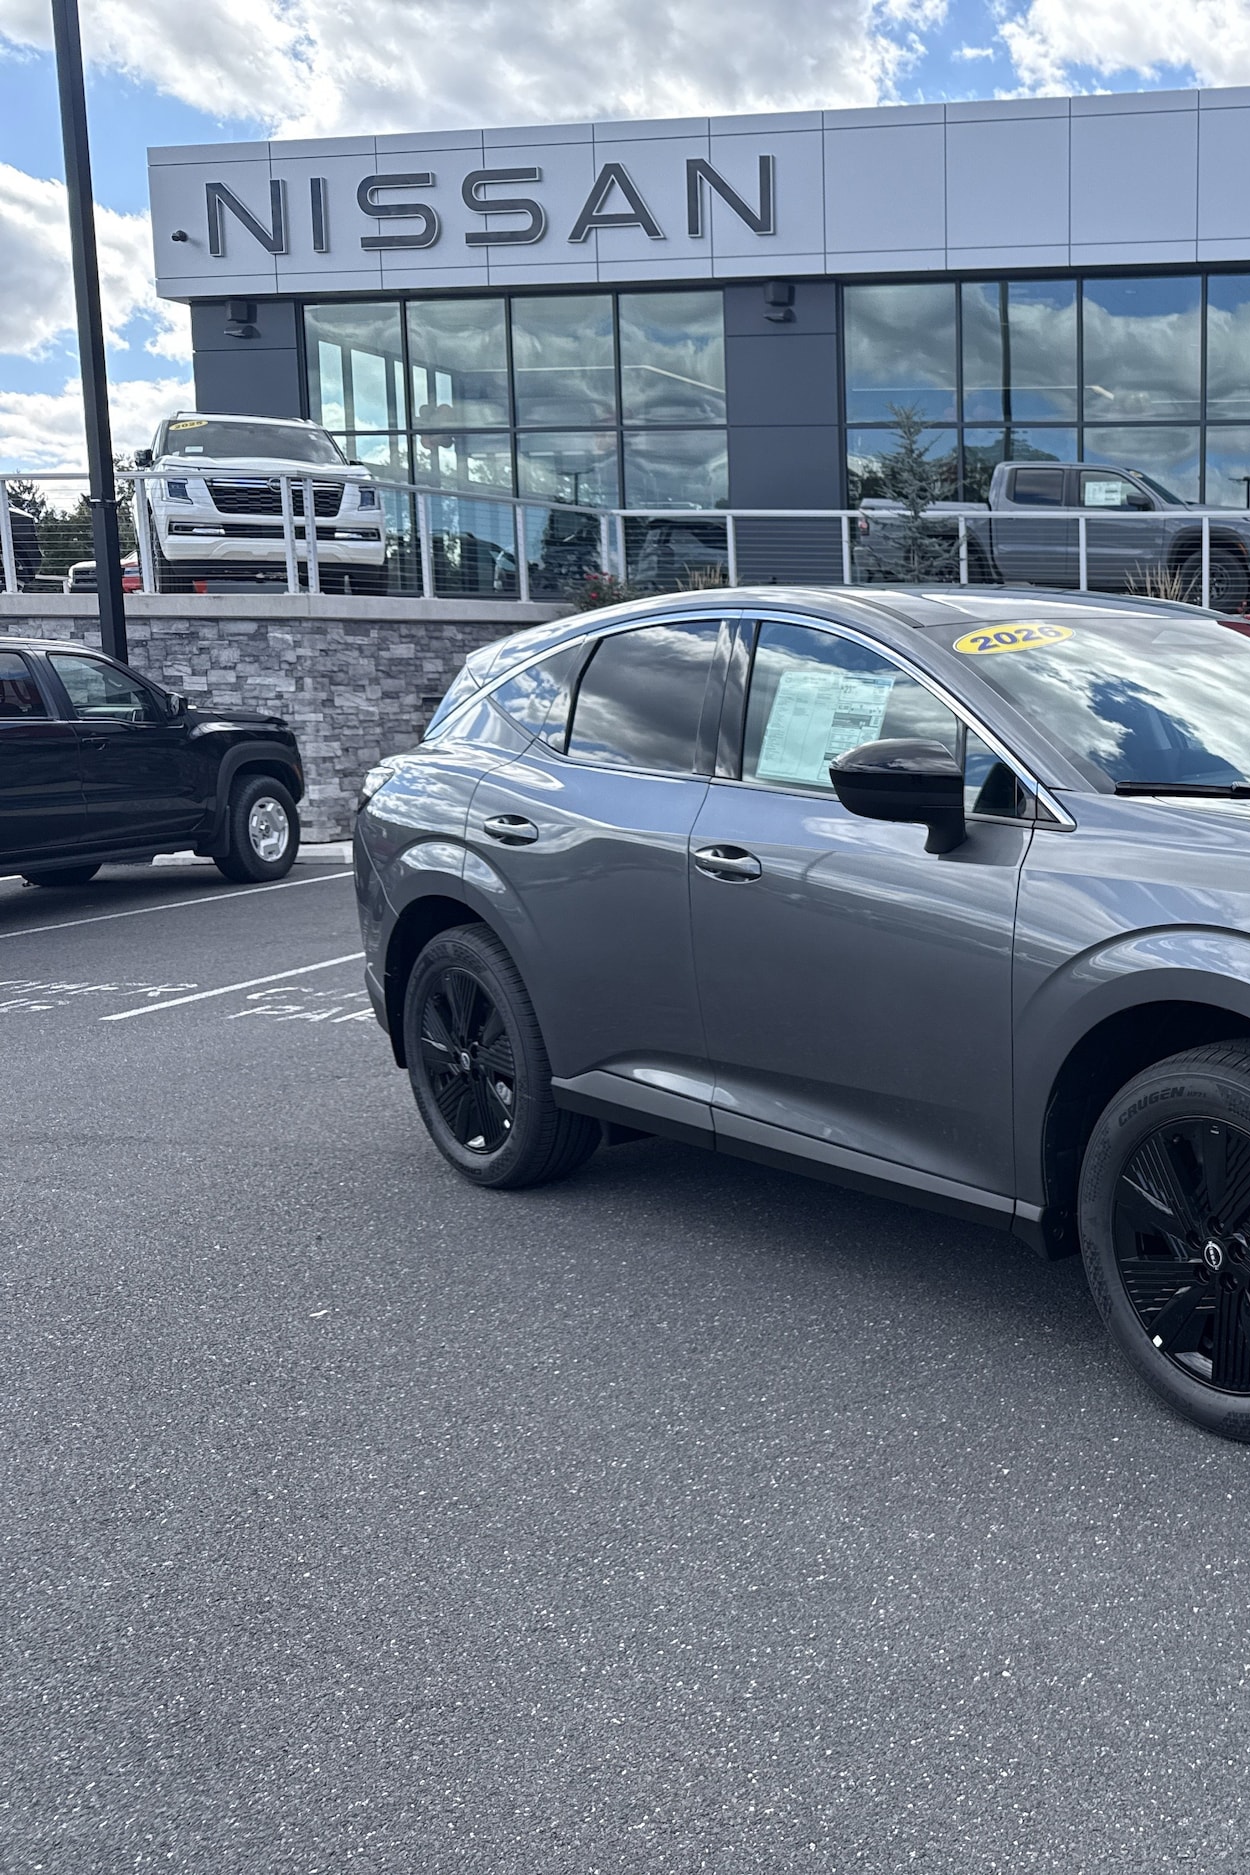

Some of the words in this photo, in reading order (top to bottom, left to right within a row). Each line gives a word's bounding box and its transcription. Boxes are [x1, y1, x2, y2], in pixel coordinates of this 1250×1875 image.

[204, 154, 777, 257] NISSAN
[970, 626, 1064, 652] 2026
[1118, 1086, 1186, 1128] CRUGEN
